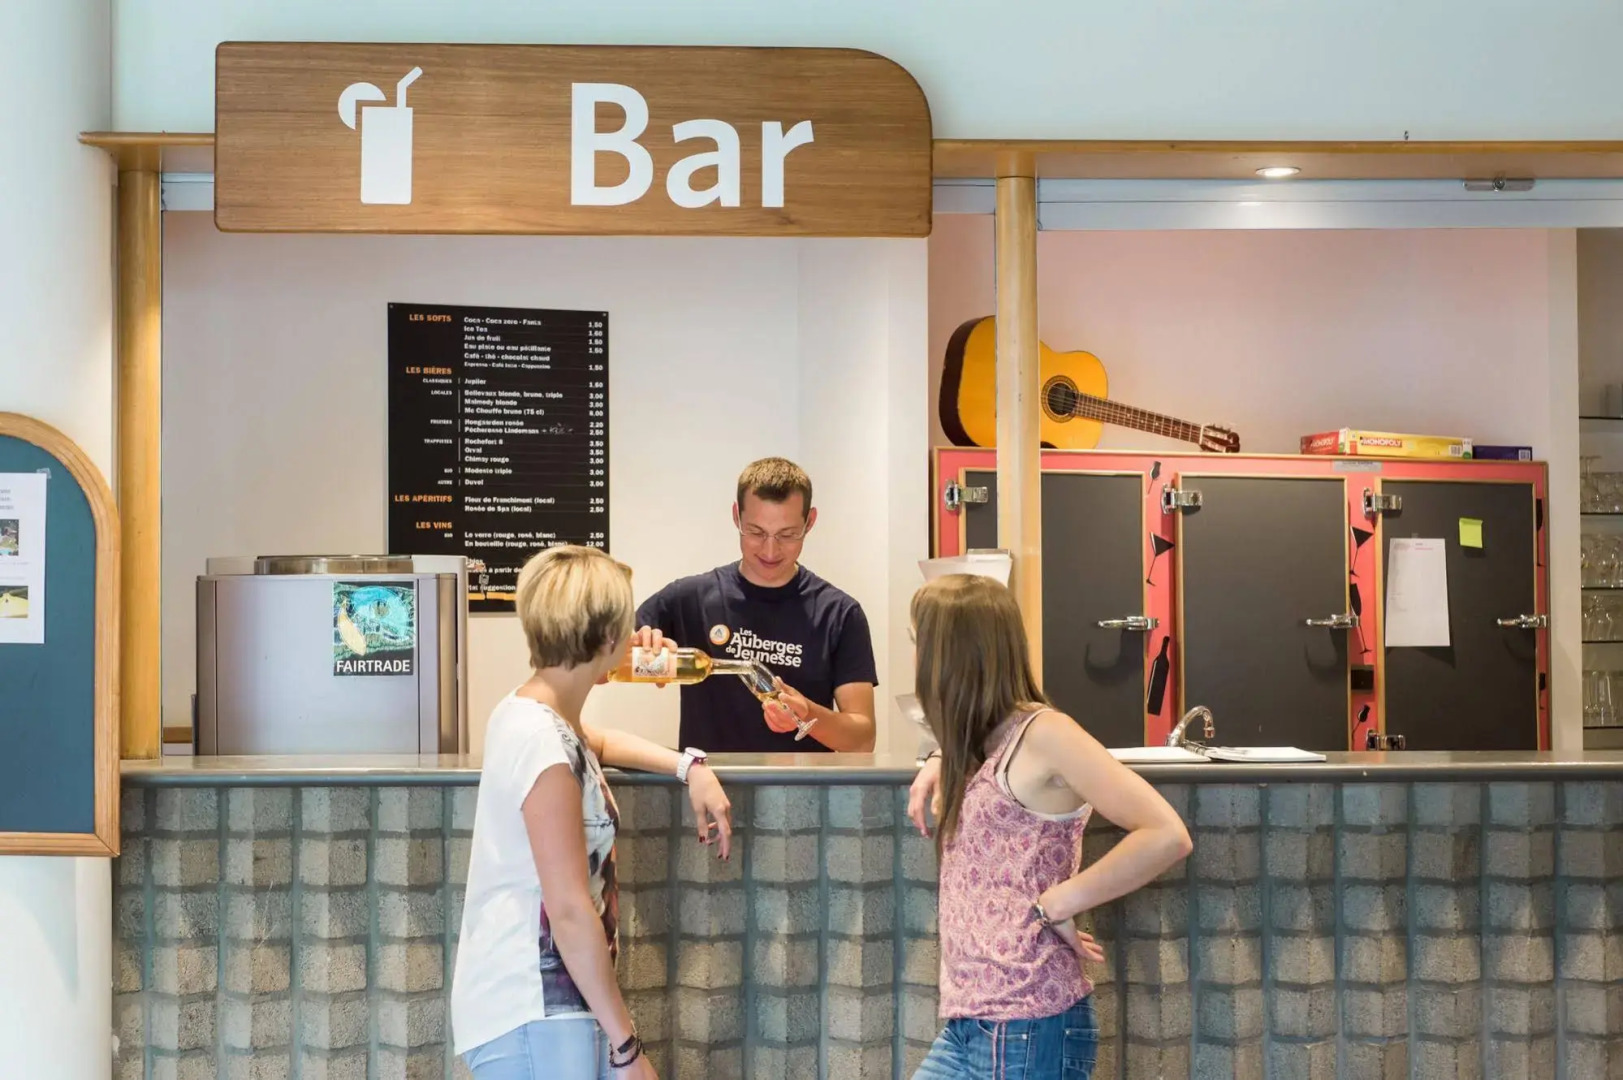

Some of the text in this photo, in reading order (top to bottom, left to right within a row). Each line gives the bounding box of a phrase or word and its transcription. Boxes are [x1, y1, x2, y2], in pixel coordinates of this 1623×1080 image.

[571, 82, 814, 208] Bar
[423, 366, 452, 374] BIÈRES
[1362, 438, 1402, 446] MONOPOLY
[740, 628, 752, 636] Les
[730, 632, 802, 655] Auberges
[726, 645, 802, 667] de Jeunesse
[336, 660, 410, 672] FAIRTRADE
